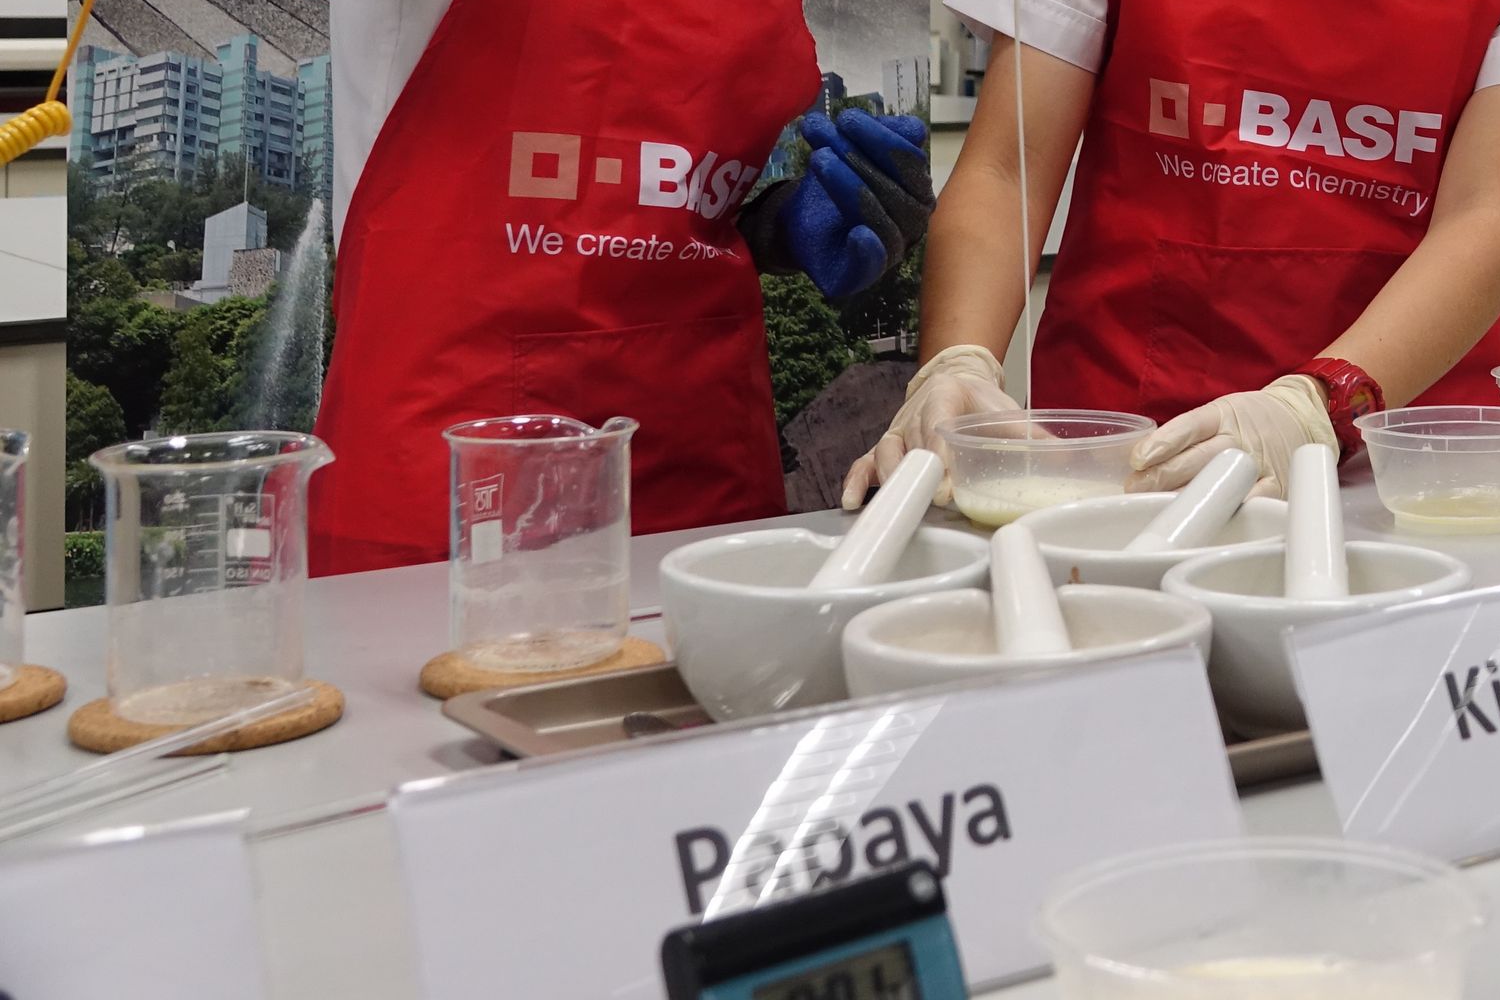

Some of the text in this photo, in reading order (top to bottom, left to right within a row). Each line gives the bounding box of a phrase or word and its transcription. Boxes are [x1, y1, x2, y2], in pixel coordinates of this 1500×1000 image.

[1238, 89, 1443, 164] BASF
[1155, 151, 1429, 217] We create chemistry
[505, 222, 563, 255] We
[576, 232, 673, 260] create
